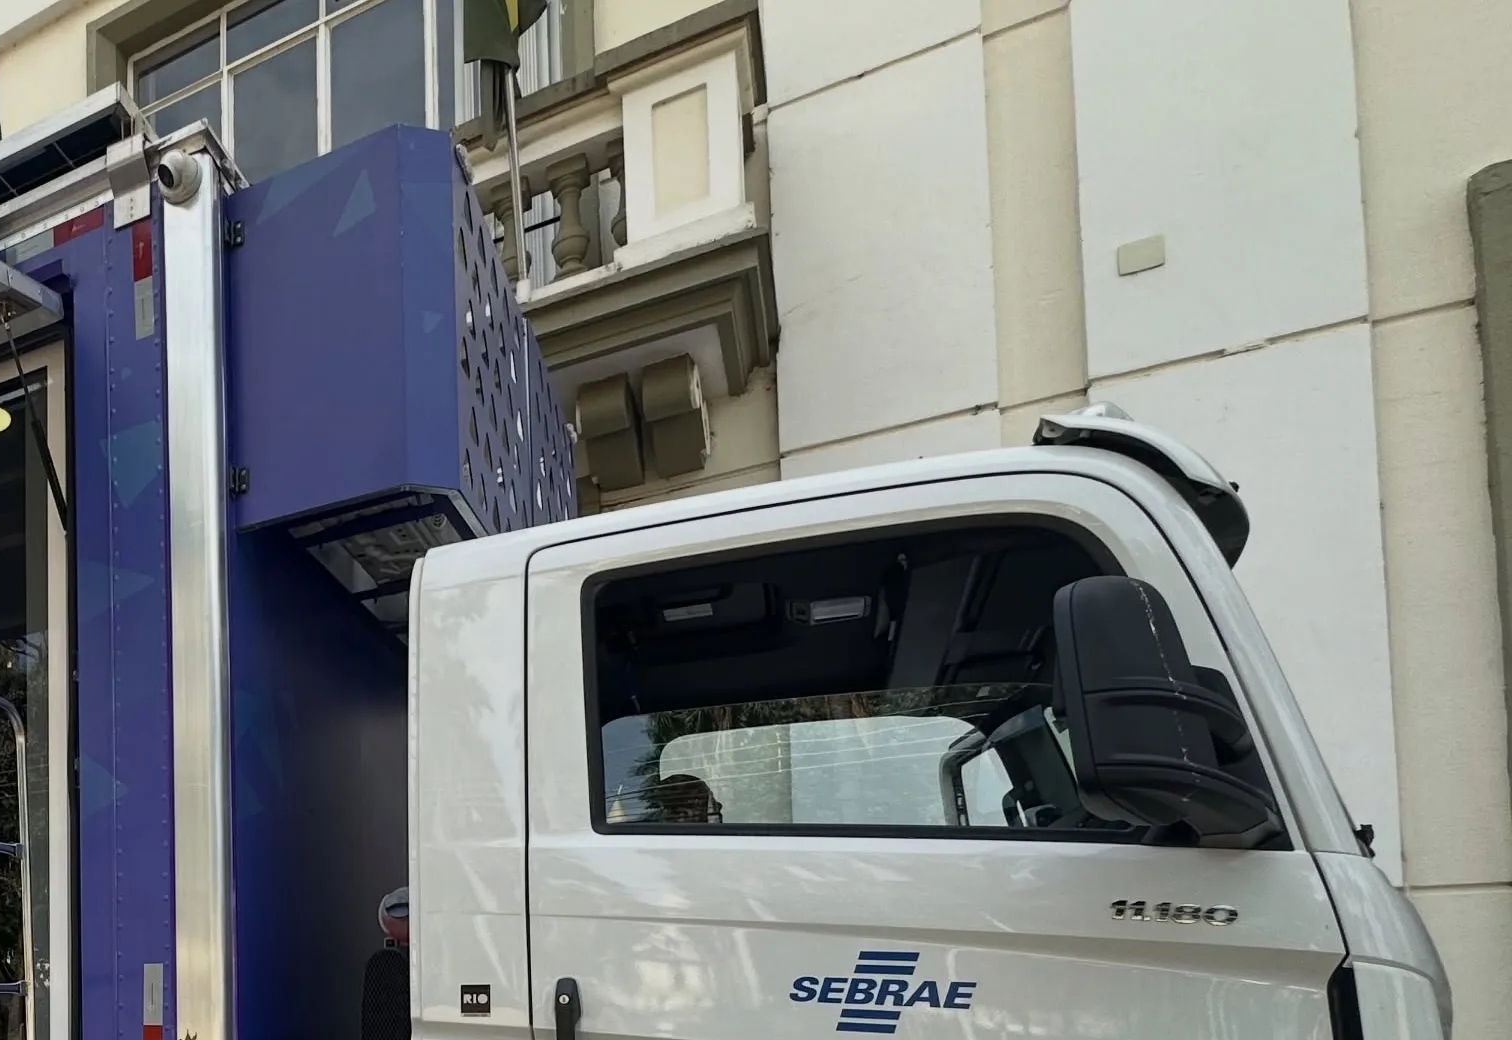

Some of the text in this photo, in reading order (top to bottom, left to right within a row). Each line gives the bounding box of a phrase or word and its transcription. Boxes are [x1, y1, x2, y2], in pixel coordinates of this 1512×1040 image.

[1110, 899, 1238, 926] 11.180
[463, 993, 489, 1004] RIO
[789, 976, 977, 1010] SEBRAE
